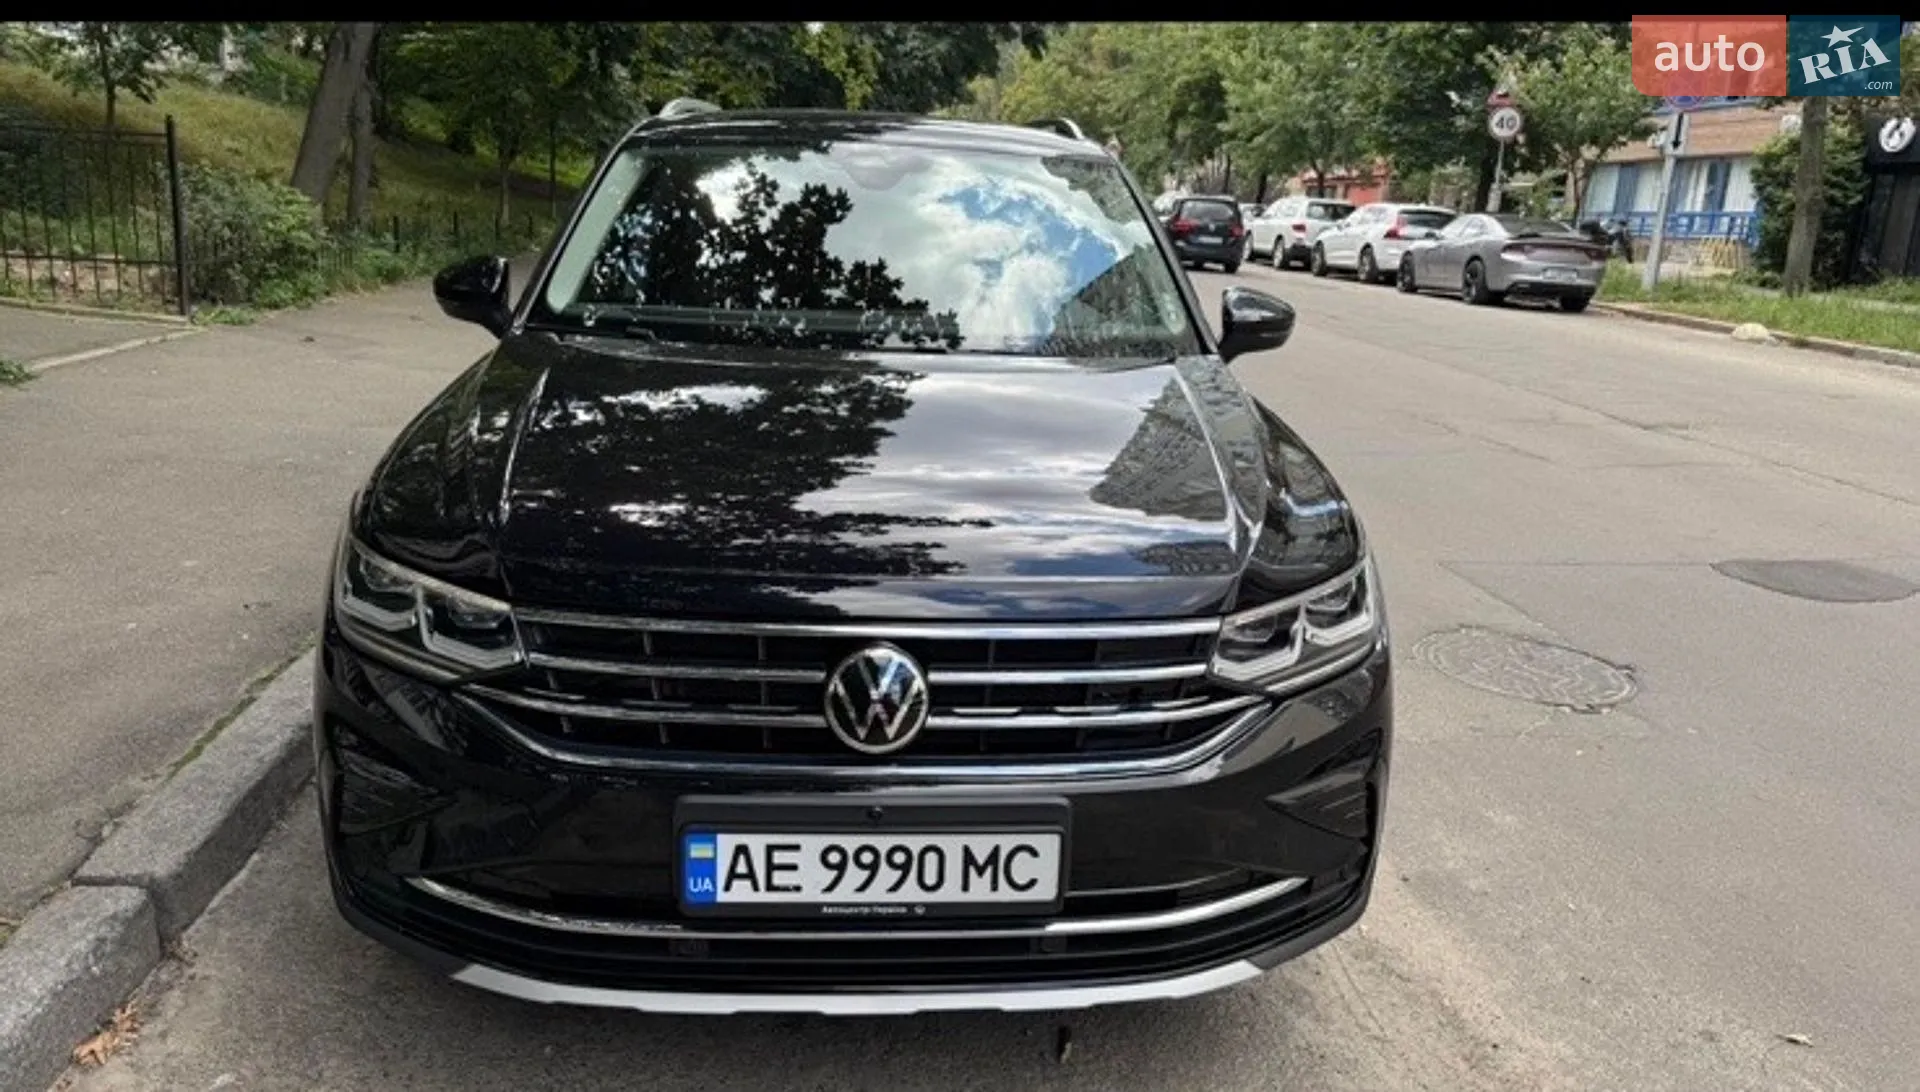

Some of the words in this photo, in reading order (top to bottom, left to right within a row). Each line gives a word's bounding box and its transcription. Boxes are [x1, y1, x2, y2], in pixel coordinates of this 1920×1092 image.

[1495, 116, 1518, 131] 40
[722, 843, 803, 893] AE
[819, 843, 947, 893] 9990
[961, 843, 1042, 893] MC
[689, 877, 714, 894] UA
